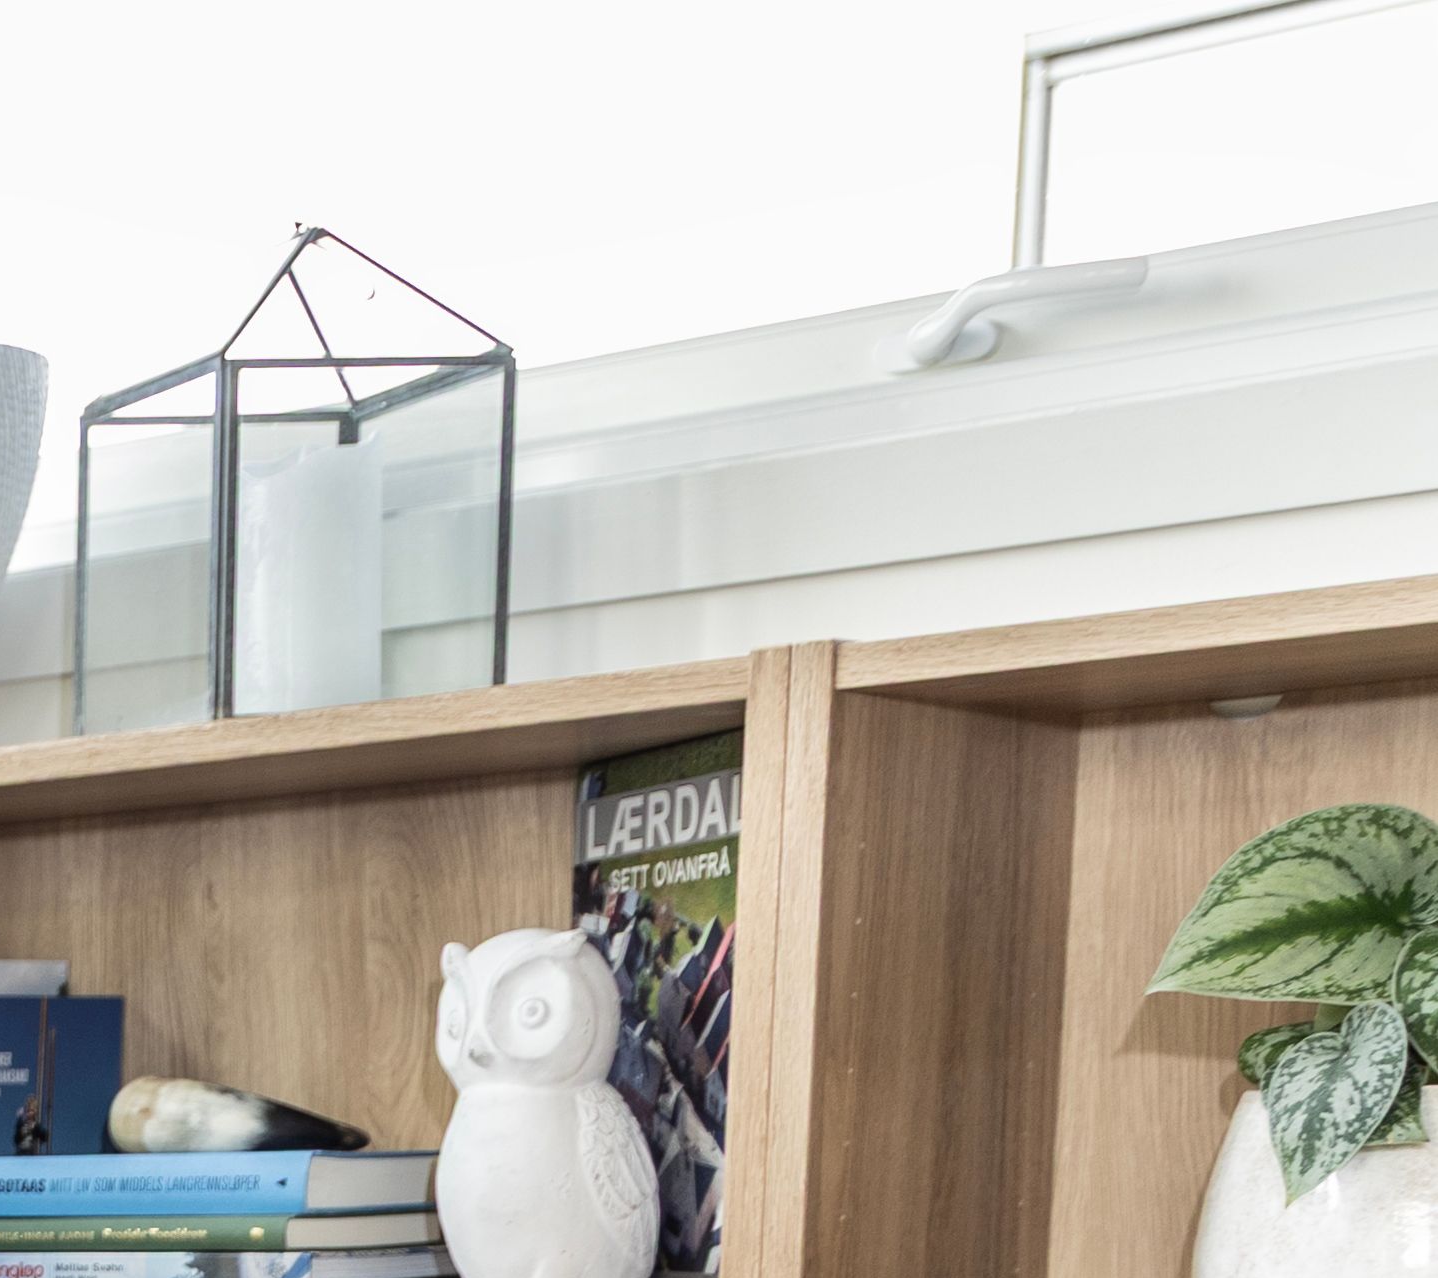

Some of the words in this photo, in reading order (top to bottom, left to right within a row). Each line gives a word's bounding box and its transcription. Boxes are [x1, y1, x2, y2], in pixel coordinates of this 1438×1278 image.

[609, 863, 650, 893] SETT
[652, 845, 732, 888] OVANFRÅ
[50, 1177, 74, 1193] MITT
[93, 1177, 117, 1192] SOM
[119, 1175, 164, 1192] MIDDELS
